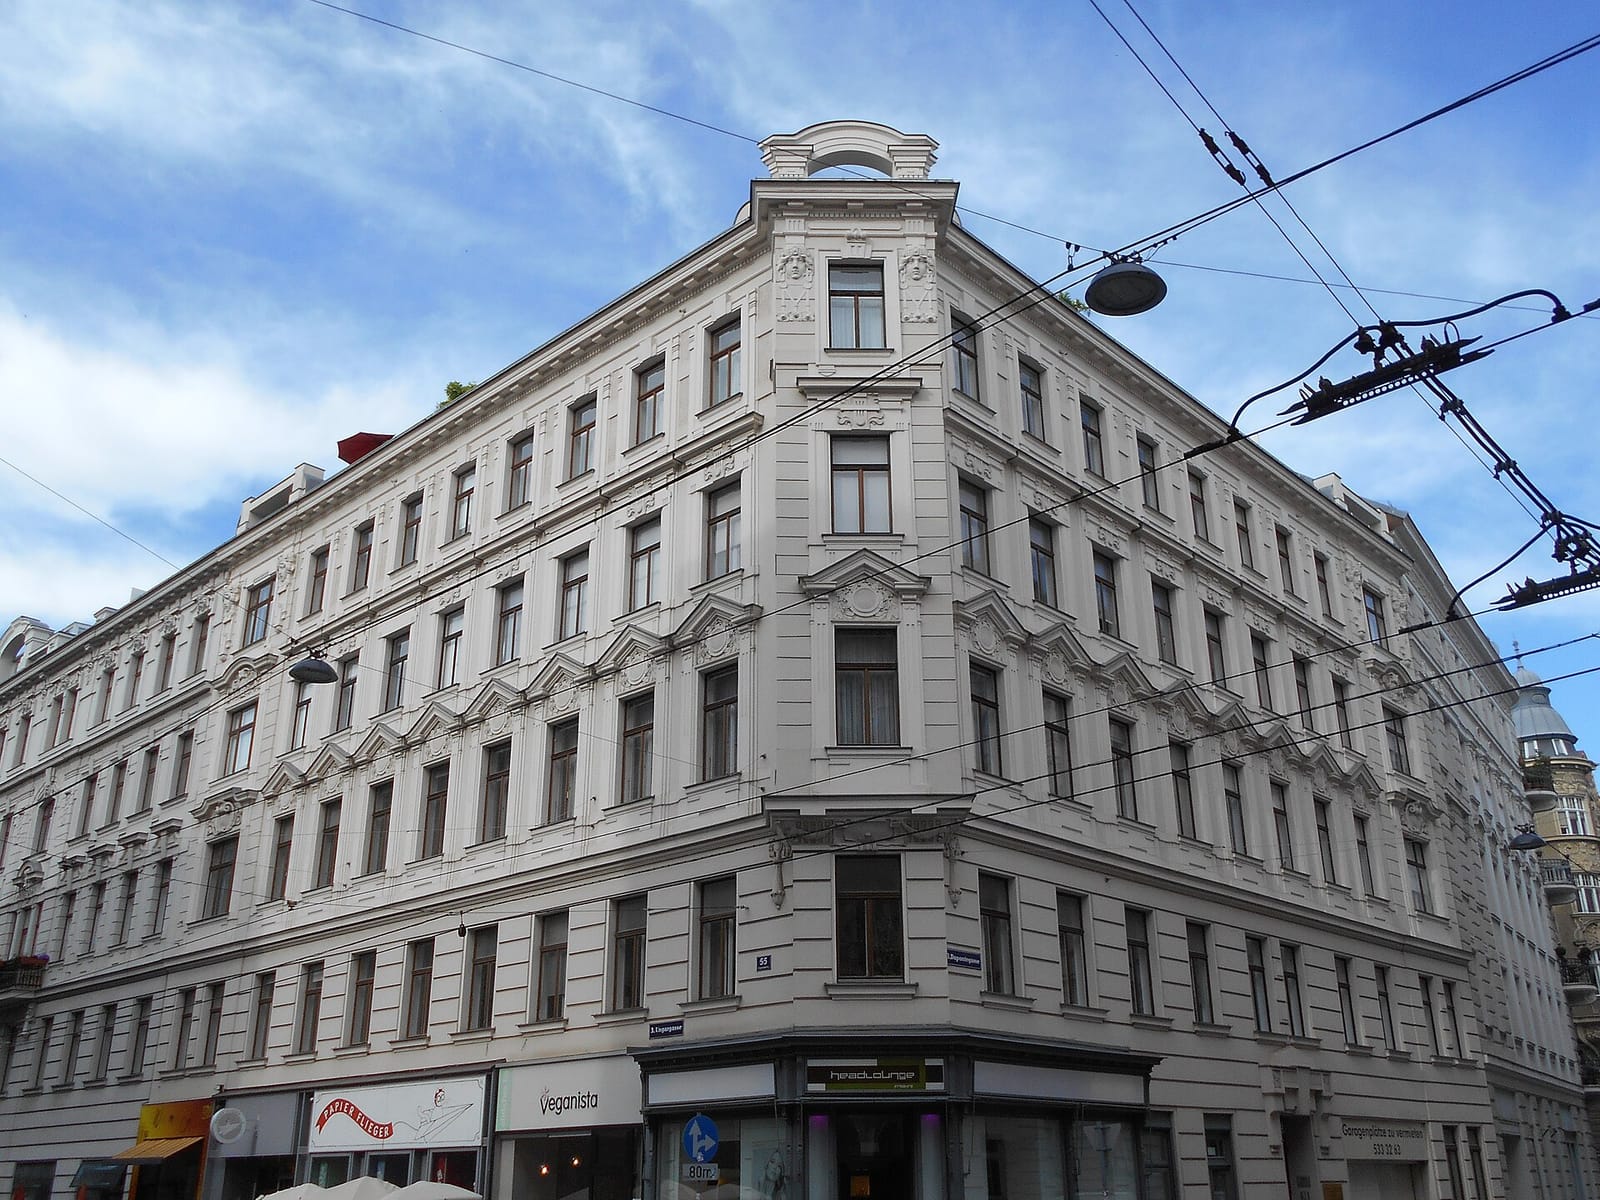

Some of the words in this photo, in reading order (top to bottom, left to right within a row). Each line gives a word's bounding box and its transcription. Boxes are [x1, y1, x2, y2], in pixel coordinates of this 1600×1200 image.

[759, 957, 768, 966] 55
[323, 1101, 355, 1120] PAPIER
[356, 1112, 389, 1137] FLIEGER
[1388, 1128, 1395, 1138] zu
[1396, 1127, 1424, 1139] vermieten
[1373, 1143, 1385, 1155] 533
[689, 1165, 712, 1179] 80m
